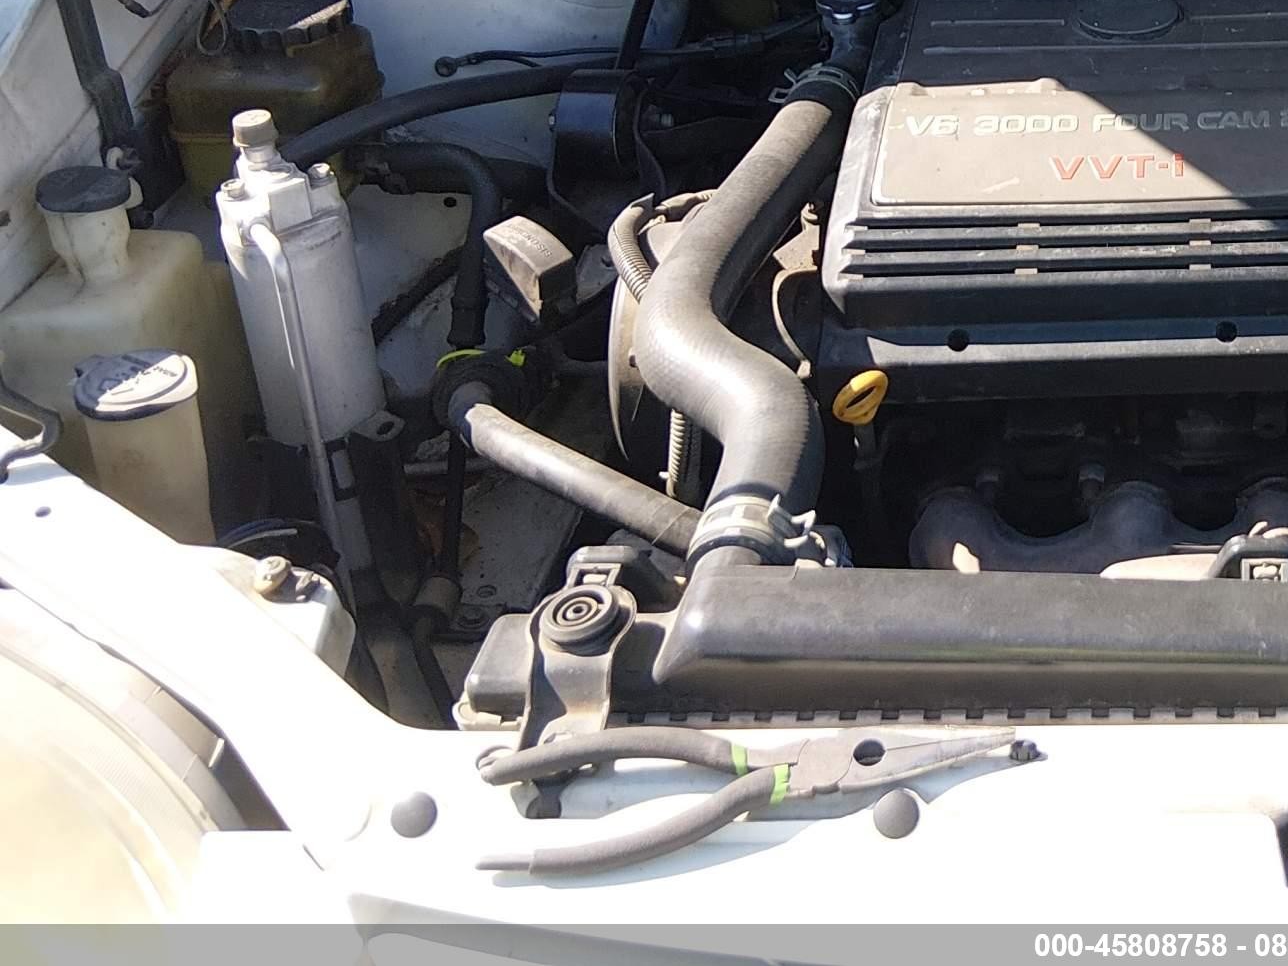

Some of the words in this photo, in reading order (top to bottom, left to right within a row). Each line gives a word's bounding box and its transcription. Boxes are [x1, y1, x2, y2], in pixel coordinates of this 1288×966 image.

[905, 115, 959, 139] V6
[973, 113, 1079, 136] 3000
[1092, 112, 1190, 134] FOUR
[1196, 110, 1272, 131] CAM
[1049, 151, 1186, 181] VVT-i
